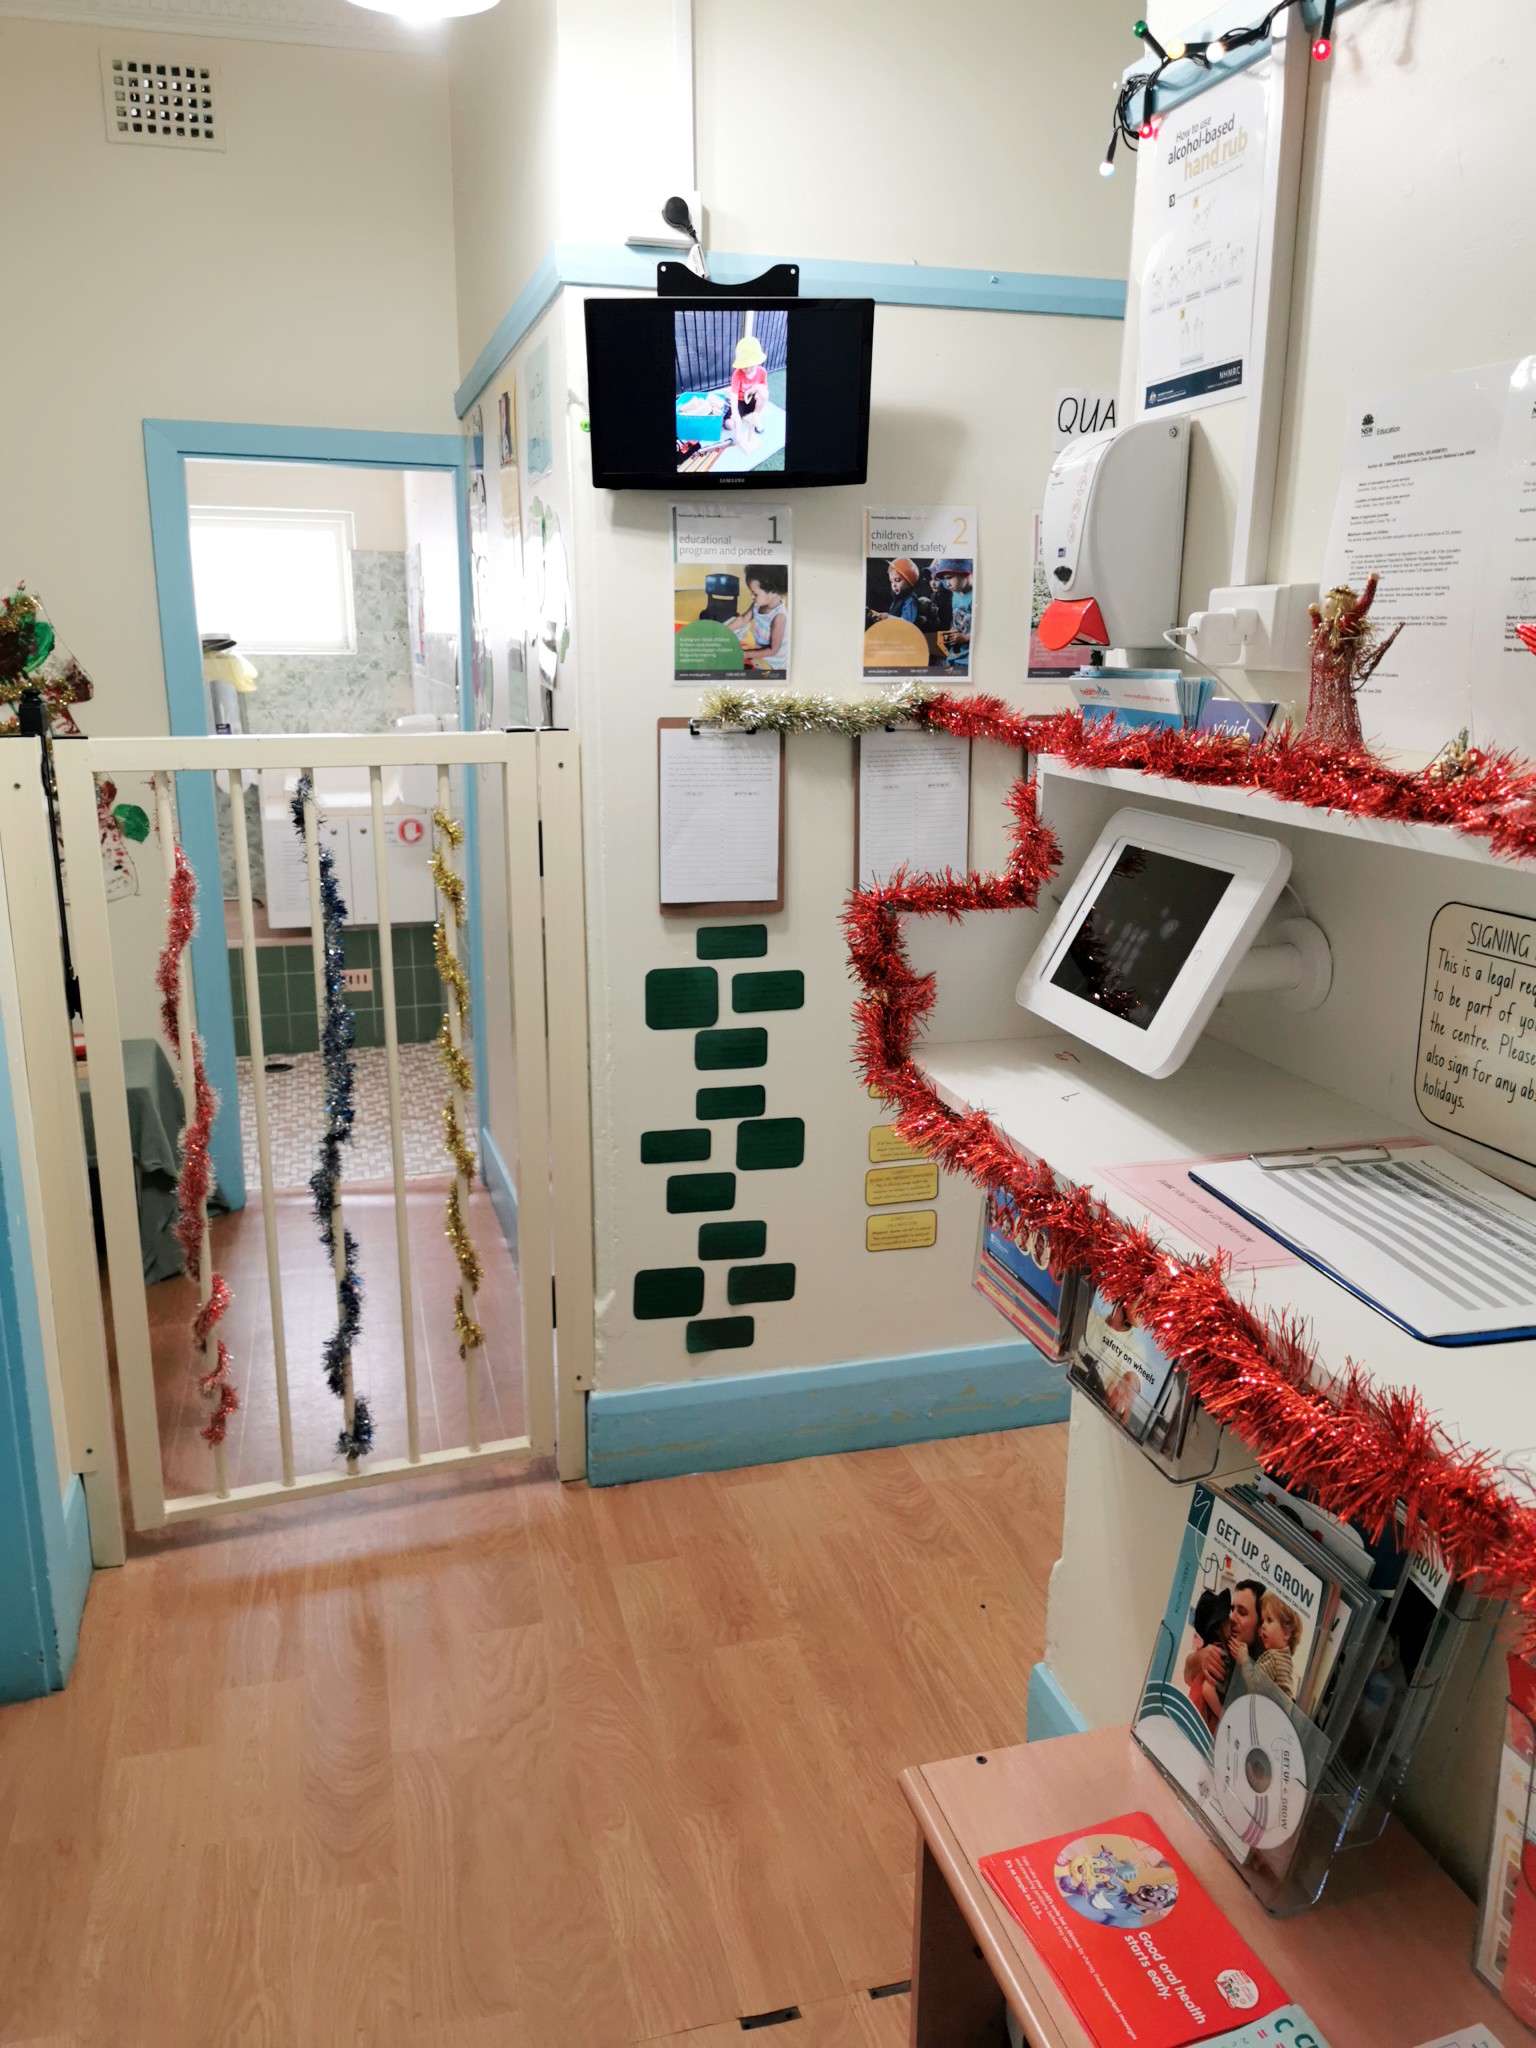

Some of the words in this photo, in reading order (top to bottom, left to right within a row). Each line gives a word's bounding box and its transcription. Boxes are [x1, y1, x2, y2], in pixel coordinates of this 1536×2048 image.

[1168, 112, 1235, 165] alcohol-based
[1176, 130, 1191, 143] How
[1192, 124, 1199, 135] to
[1200, 116, 1212, 129] use
[1184, 139, 1220, 182] hand
[1222, 126, 1248, 161] rub
[1219, 366, 1241, 380] NHMRC
[1361, 427, 1373, 435] NSW
[1376, 426, 1400, 436] Education
[678, 535, 732, 545] educational
[767, 515, 783, 544] 1
[871, 530, 914, 540] children's
[952, 517, 968, 545] 2
[679, 546, 718, 557] program
[719, 546, 736, 556] and
[738, 546, 773, 557] practice
[871, 542, 900, 552] health
[901, 542, 919, 552] and
[920, 542, 947, 554] safety
[1213, 719, 1250, 738] vivid
[1467, 922, 1530, 958] SIGNING
[1439, 947, 1458, 974] This
[1462, 959, 1471, 978] is
[1476, 969, 1483, 981] a
[1487, 962, 1516, 997] legal
[1433, 980, 1444, 1002] to
[1449, 985, 1461, 1008] be
[1466, 996, 1492, 1021] part
[1498, 1002, 1516, 1023] of
[1518, 1015, 1536, 1038] yo
[1430, 1011, 1445, 1035] the
[1452, 1025, 1489, 1051] centre.
[1498, 1033, 1536, 1066] Please
[1426, 1043, 1445, 1068] also
[1447, 1055, 1469, 1084] sign
[1472, 1059, 1492, 1084] for
[1495, 1077, 1517, 1103] any
[1520, 1078, 1536, 1102] ab
[1423, 1072, 1465, 1115] holidays.
[1102, 1336, 1123, 1357] safety
[1123, 1353, 1132, 1364] on
[1133, 1361, 1155, 1385] wheels
[1216, 1518, 1241, 1547] GET
[1241, 1537, 1259, 1561] UP
[1260, 1554, 1271, 1572] &
[1273, 1564, 1314, 1608] GROW
[1281, 1797, 1289, 1830] GROW
[1005, 1859, 1013, 1868] It's
[1014, 1874, 1027, 1893] simple
[1034, 1878, 1043, 1889] your
[1102, 1986, 1119, 2013] important
[1124, 1935, 1151, 1968] starts
[1147, 1969, 1171, 2000] early.
[1138, 1931, 1165, 1962] Good
[1159, 1963, 1182, 1986] oral
[1174, 1984, 1206, 2025] health
